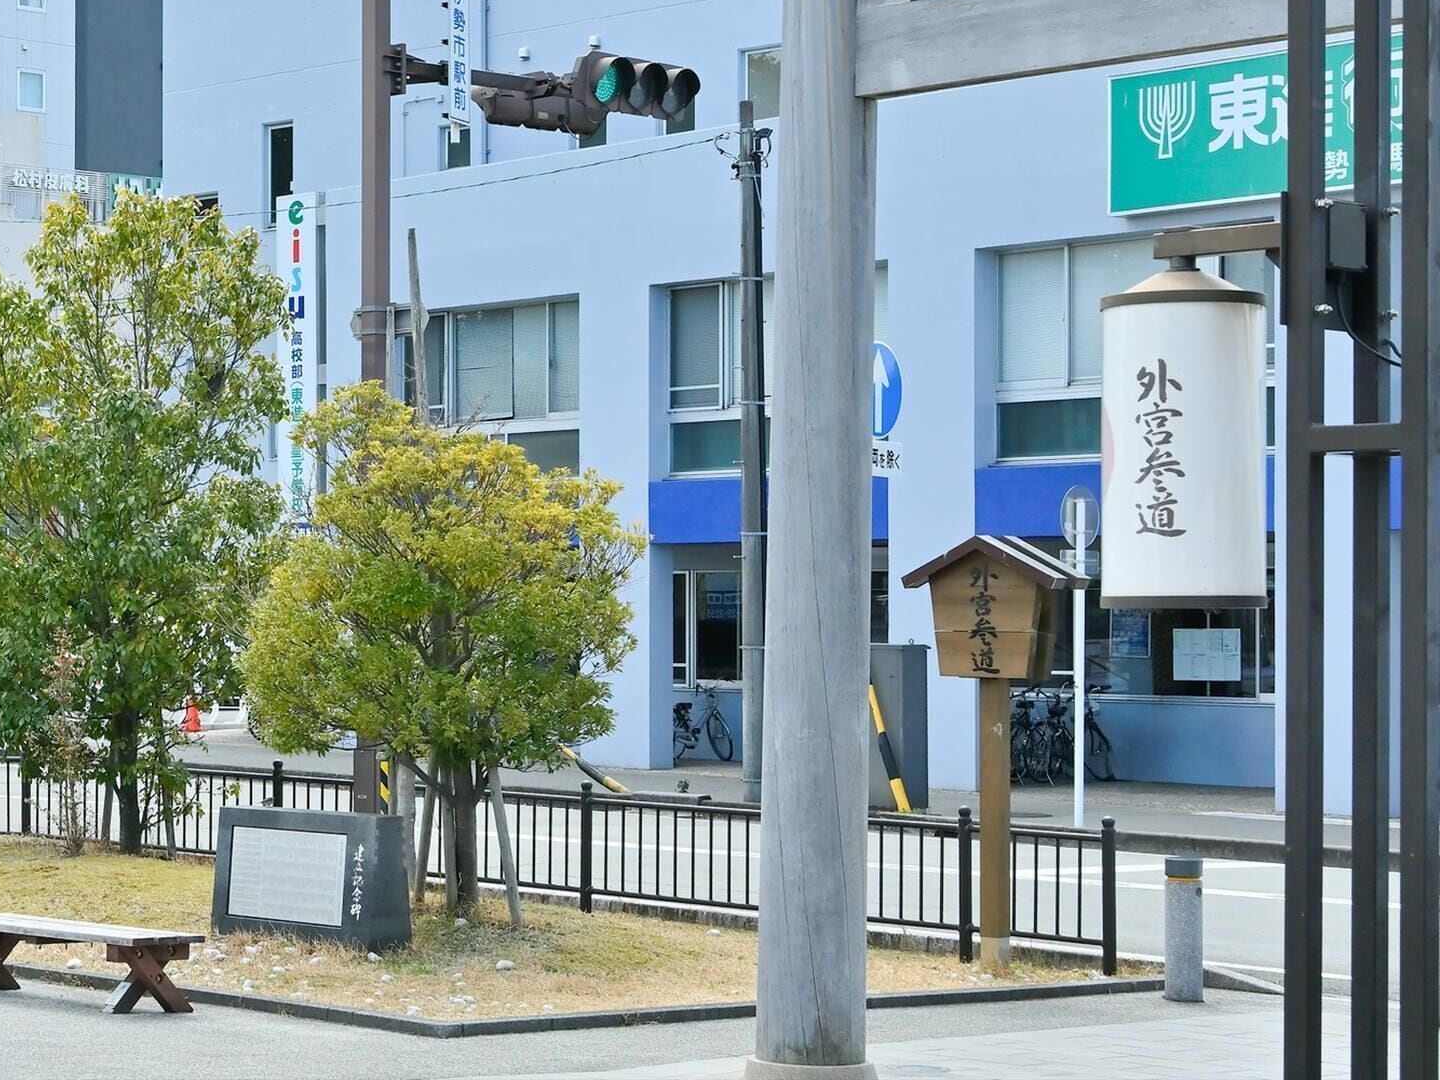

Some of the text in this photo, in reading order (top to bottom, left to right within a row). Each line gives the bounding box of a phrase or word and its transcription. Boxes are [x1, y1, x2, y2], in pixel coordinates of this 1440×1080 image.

[13, 168, 90, 194] 松村皮膚科
[288, 199, 305, 320] eisu
